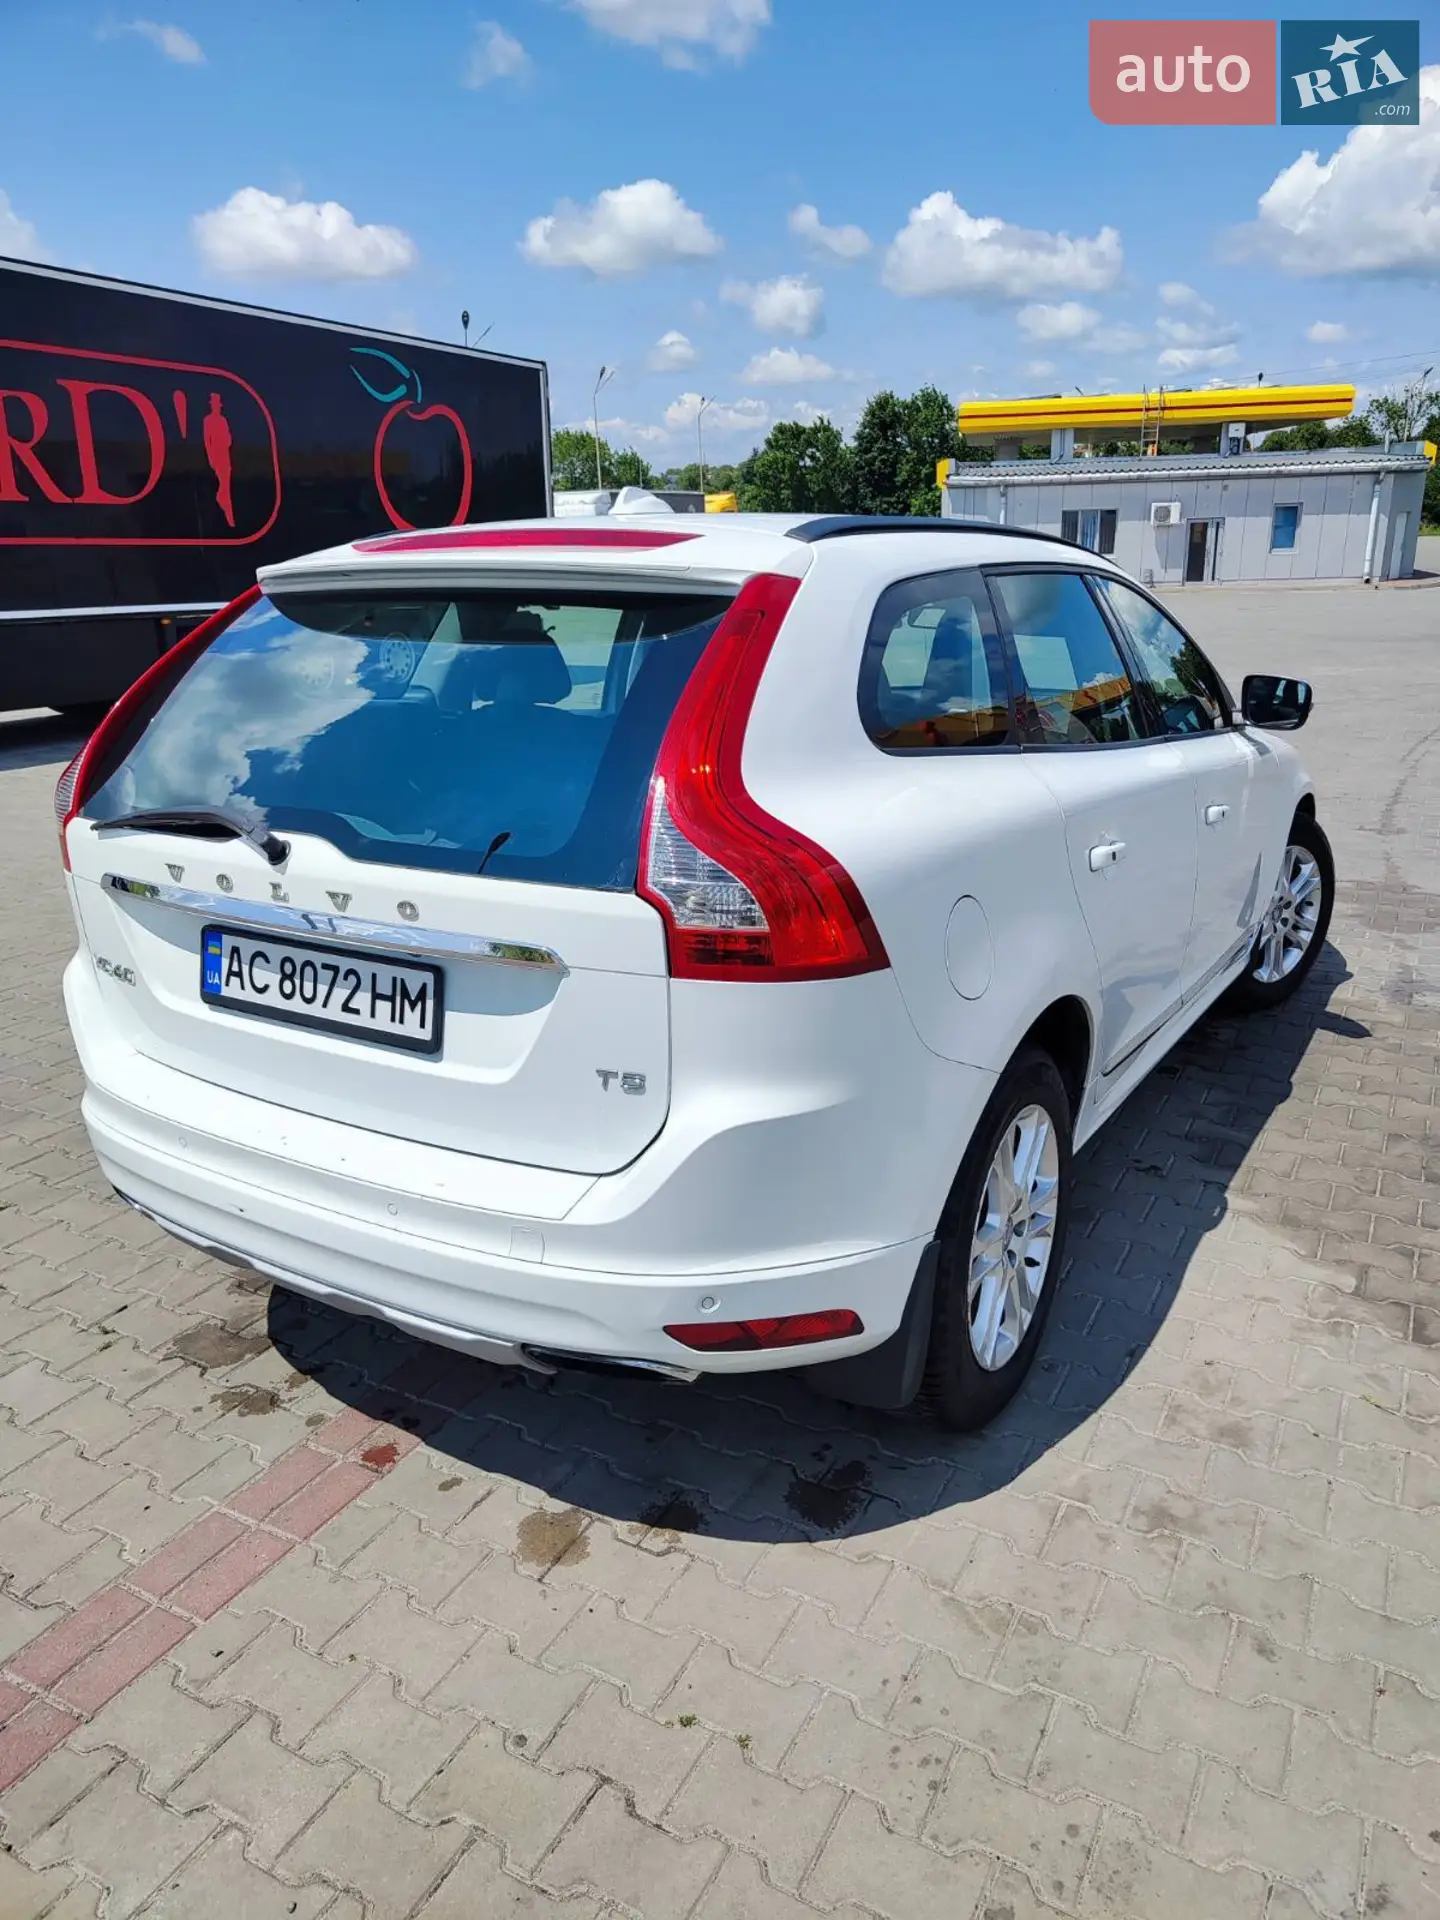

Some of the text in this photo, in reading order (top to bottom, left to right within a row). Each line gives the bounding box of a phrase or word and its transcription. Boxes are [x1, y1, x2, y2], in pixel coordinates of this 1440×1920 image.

[165, 863, 420, 922] VOLVO
[206, 970, 220, 985] UA
[278, 956, 362, 1015] 8072
